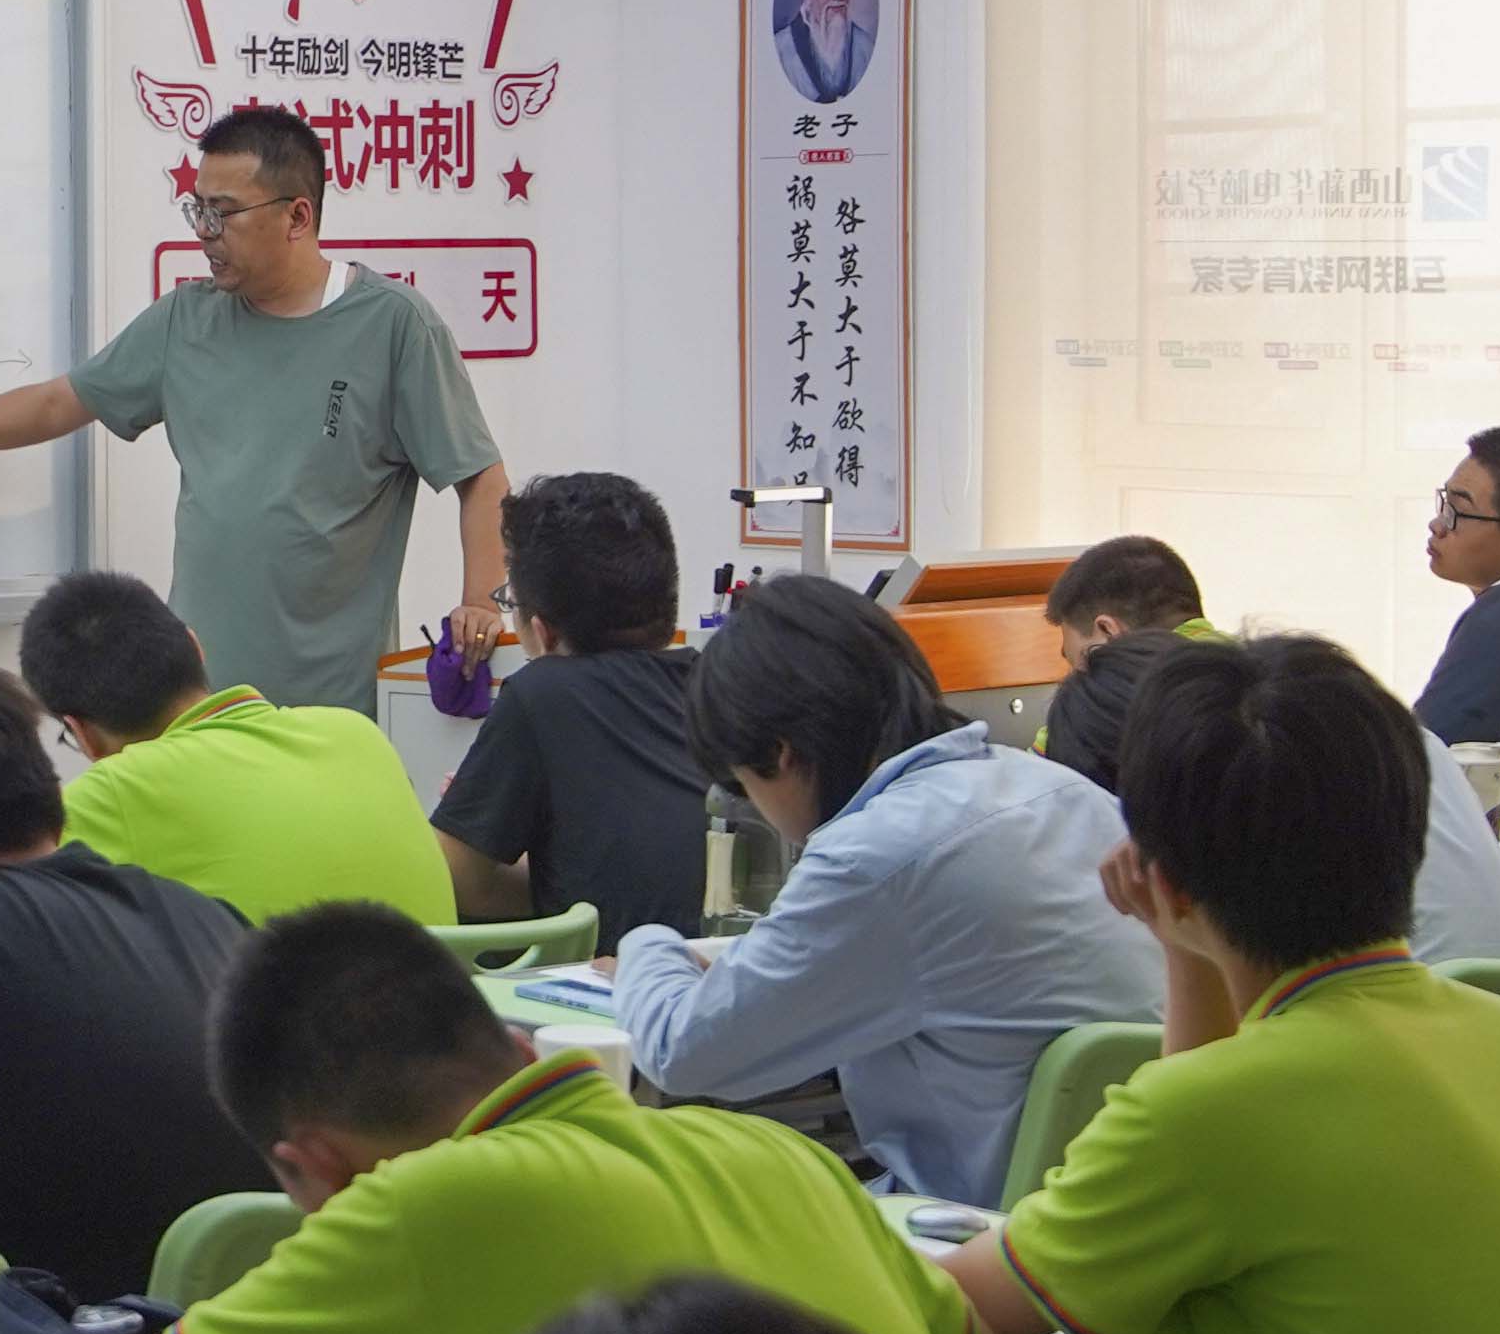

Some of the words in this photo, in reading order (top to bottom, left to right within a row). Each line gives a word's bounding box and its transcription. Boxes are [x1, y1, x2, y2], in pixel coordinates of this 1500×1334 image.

[241, 35, 349, 77] 十年励剑
[360, 38, 465, 79] 今明锋芒
[231, 97, 475, 190] 试冲刺
[792, 113, 859, 139] 老子
[481, 270, 517, 323] 天
[831, 197, 866, 488] 咎莫大于欲得
